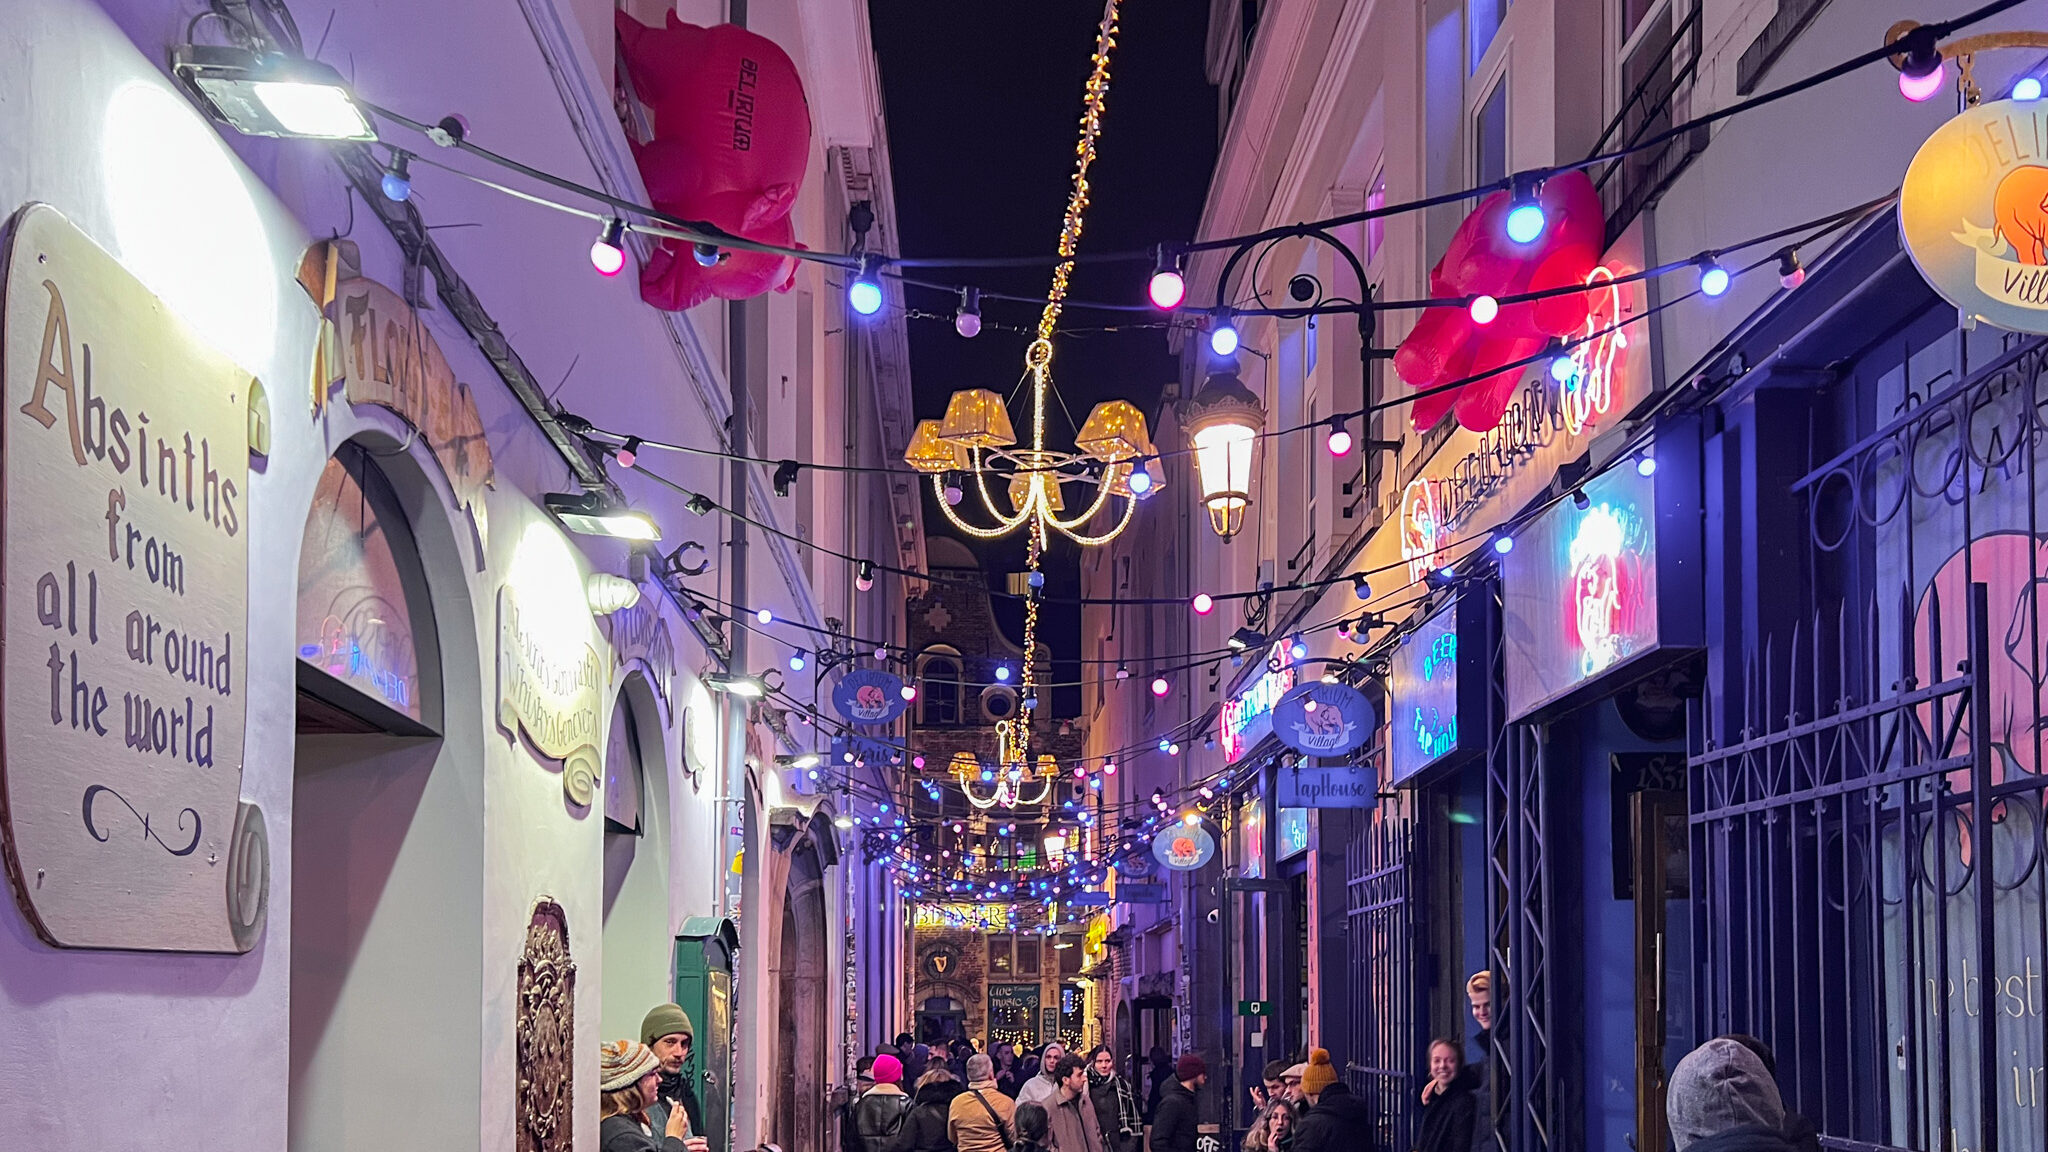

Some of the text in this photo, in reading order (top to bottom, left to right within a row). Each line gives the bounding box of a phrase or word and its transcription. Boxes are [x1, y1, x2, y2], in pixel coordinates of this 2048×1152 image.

[1966, 111, 2048, 178] DELI
[20, 279, 238, 537] Absinths
[105, 485, 184, 596] from
[37, 560, 231, 696] all around
[1424, 633, 1457, 682] BEER
[47, 641, 213, 768] the world
[1291, 773, 1367, 804] TapHouse
